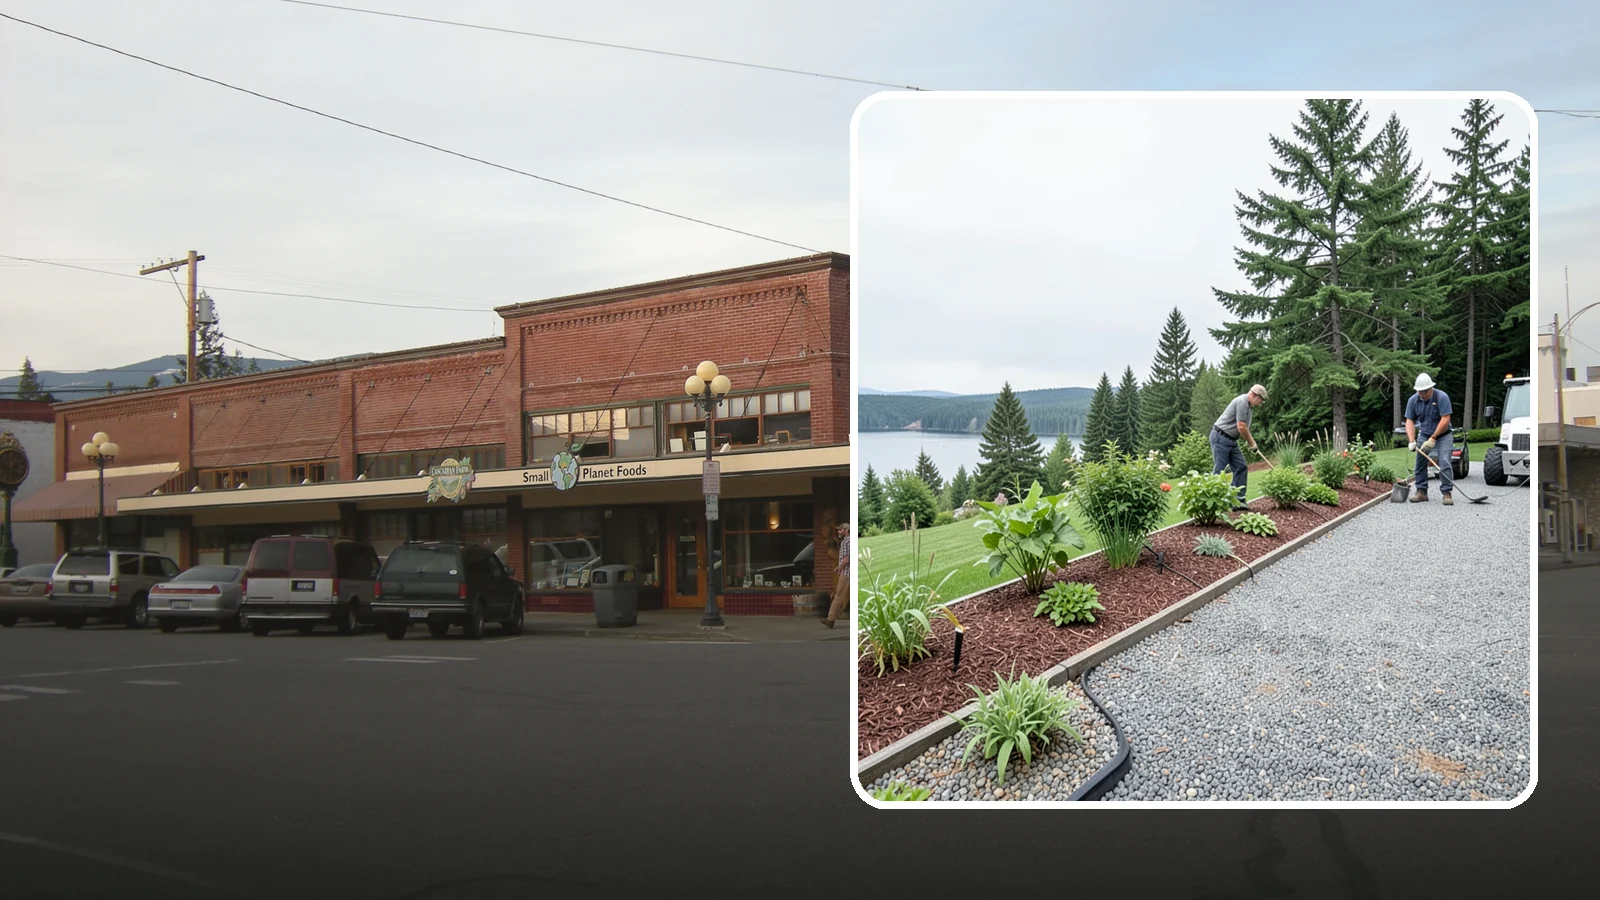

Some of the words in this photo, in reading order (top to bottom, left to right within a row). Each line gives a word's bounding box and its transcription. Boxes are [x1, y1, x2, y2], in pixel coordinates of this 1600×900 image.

[523, 471, 549, 483] Small
[582, 468, 614, 479] Planet
[616, 464, 647, 477] Foods
